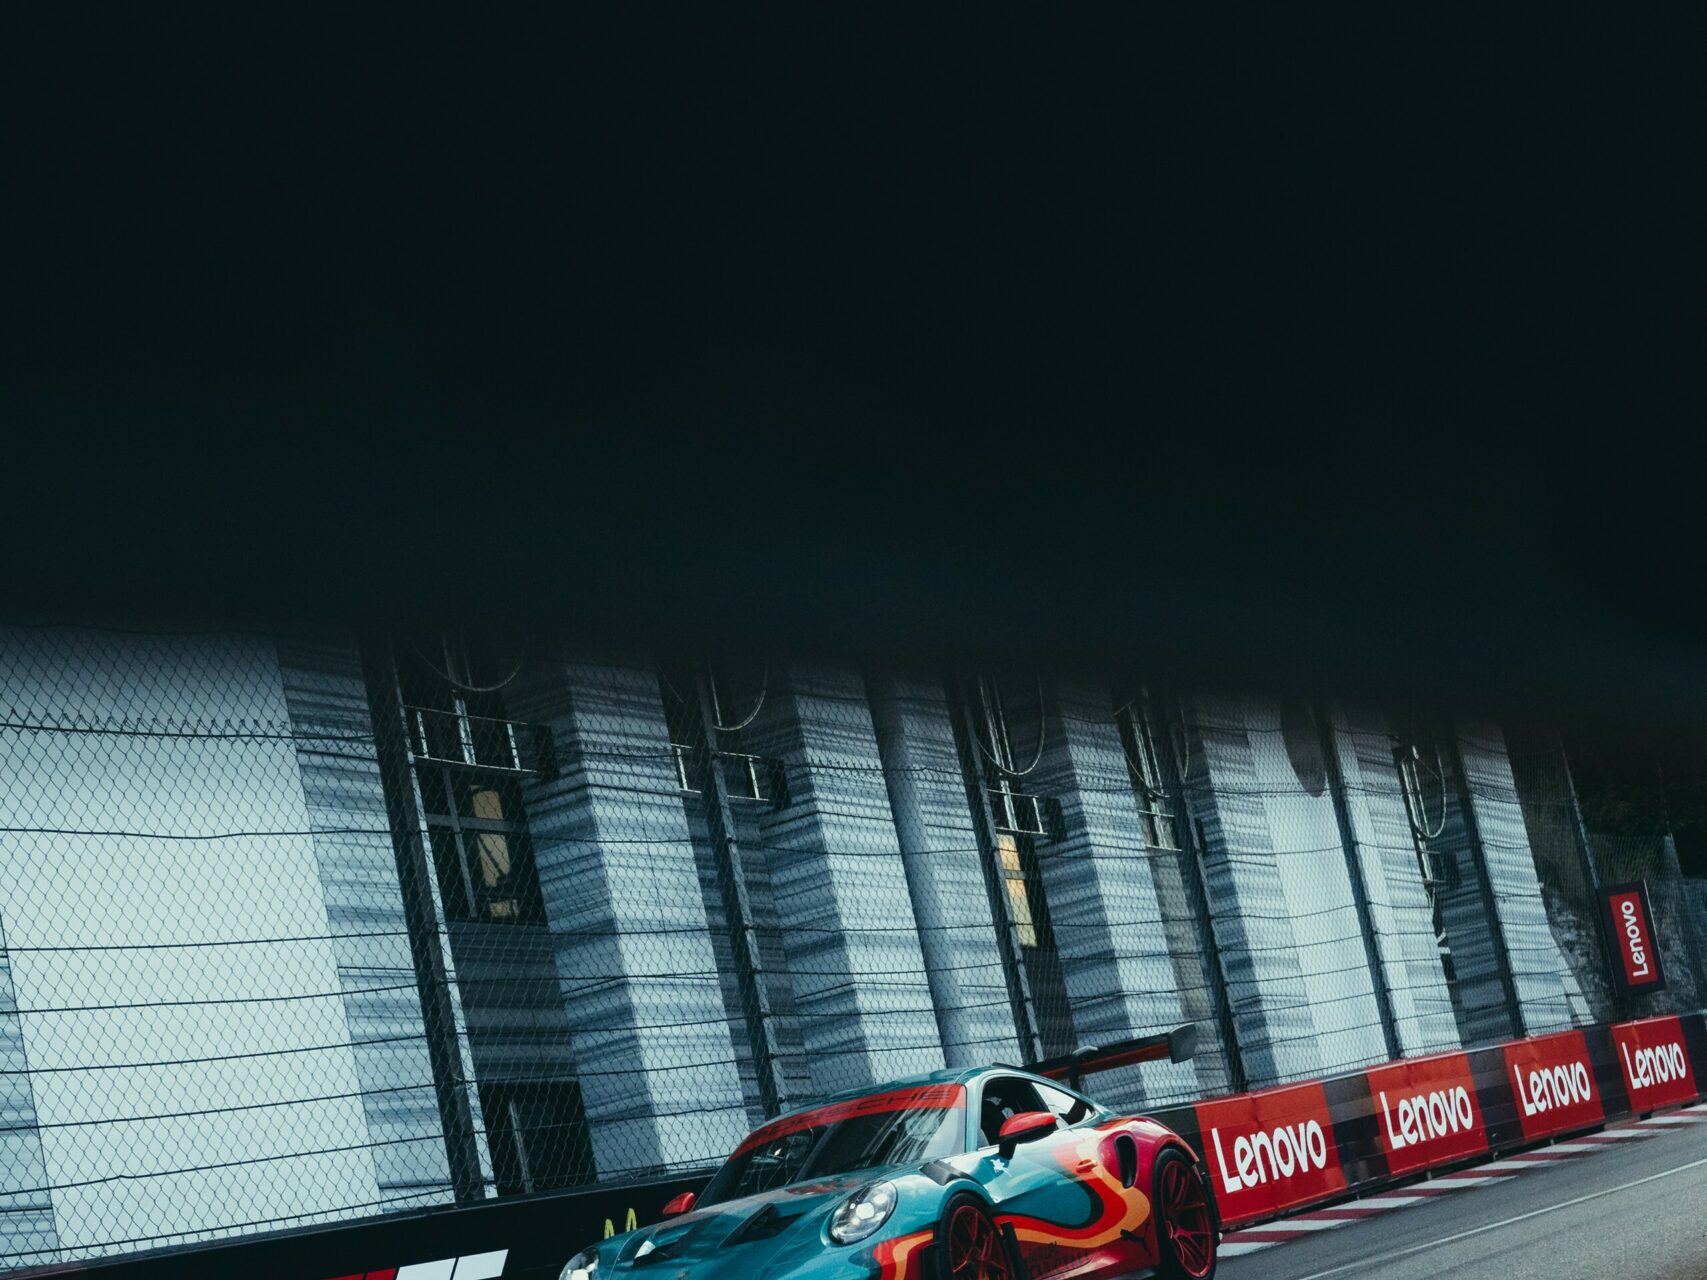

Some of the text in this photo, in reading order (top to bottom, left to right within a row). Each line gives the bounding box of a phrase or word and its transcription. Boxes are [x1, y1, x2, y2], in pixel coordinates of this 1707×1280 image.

[1621, 899, 1650, 977] Lenovo
[1513, 1061, 1591, 1117] Lenovo
[1621, 1041, 1687, 1090] Lenovo
[1378, 1084, 1474, 1150] Lenovo
[1211, 1119, 1327, 1194] Lenovo
